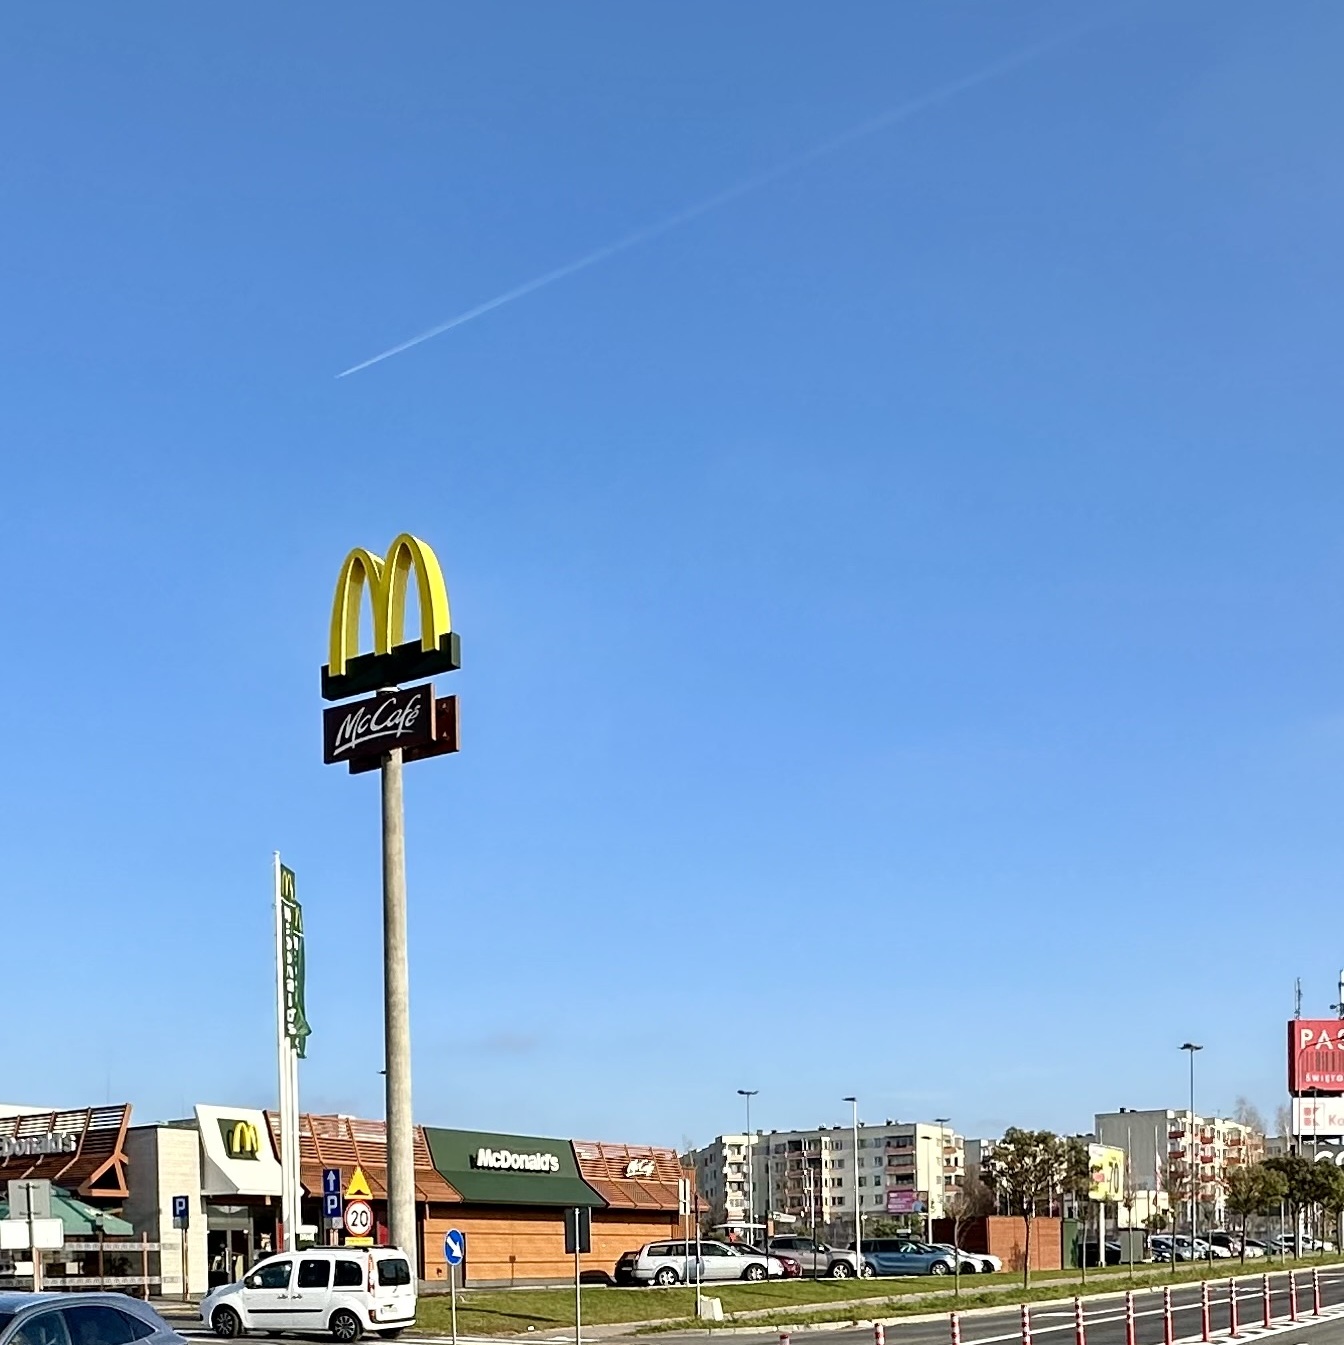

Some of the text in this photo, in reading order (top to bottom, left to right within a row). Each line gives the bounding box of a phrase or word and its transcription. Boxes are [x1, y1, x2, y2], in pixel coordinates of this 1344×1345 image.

[333, 693, 422, 753] McCafé
[476, 1148, 560, 1172] McDonald's
[176, 1198, 187, 1214] P
[327, 1196, 338, 1214] P
[351, 1210, 369, 1227] 20
